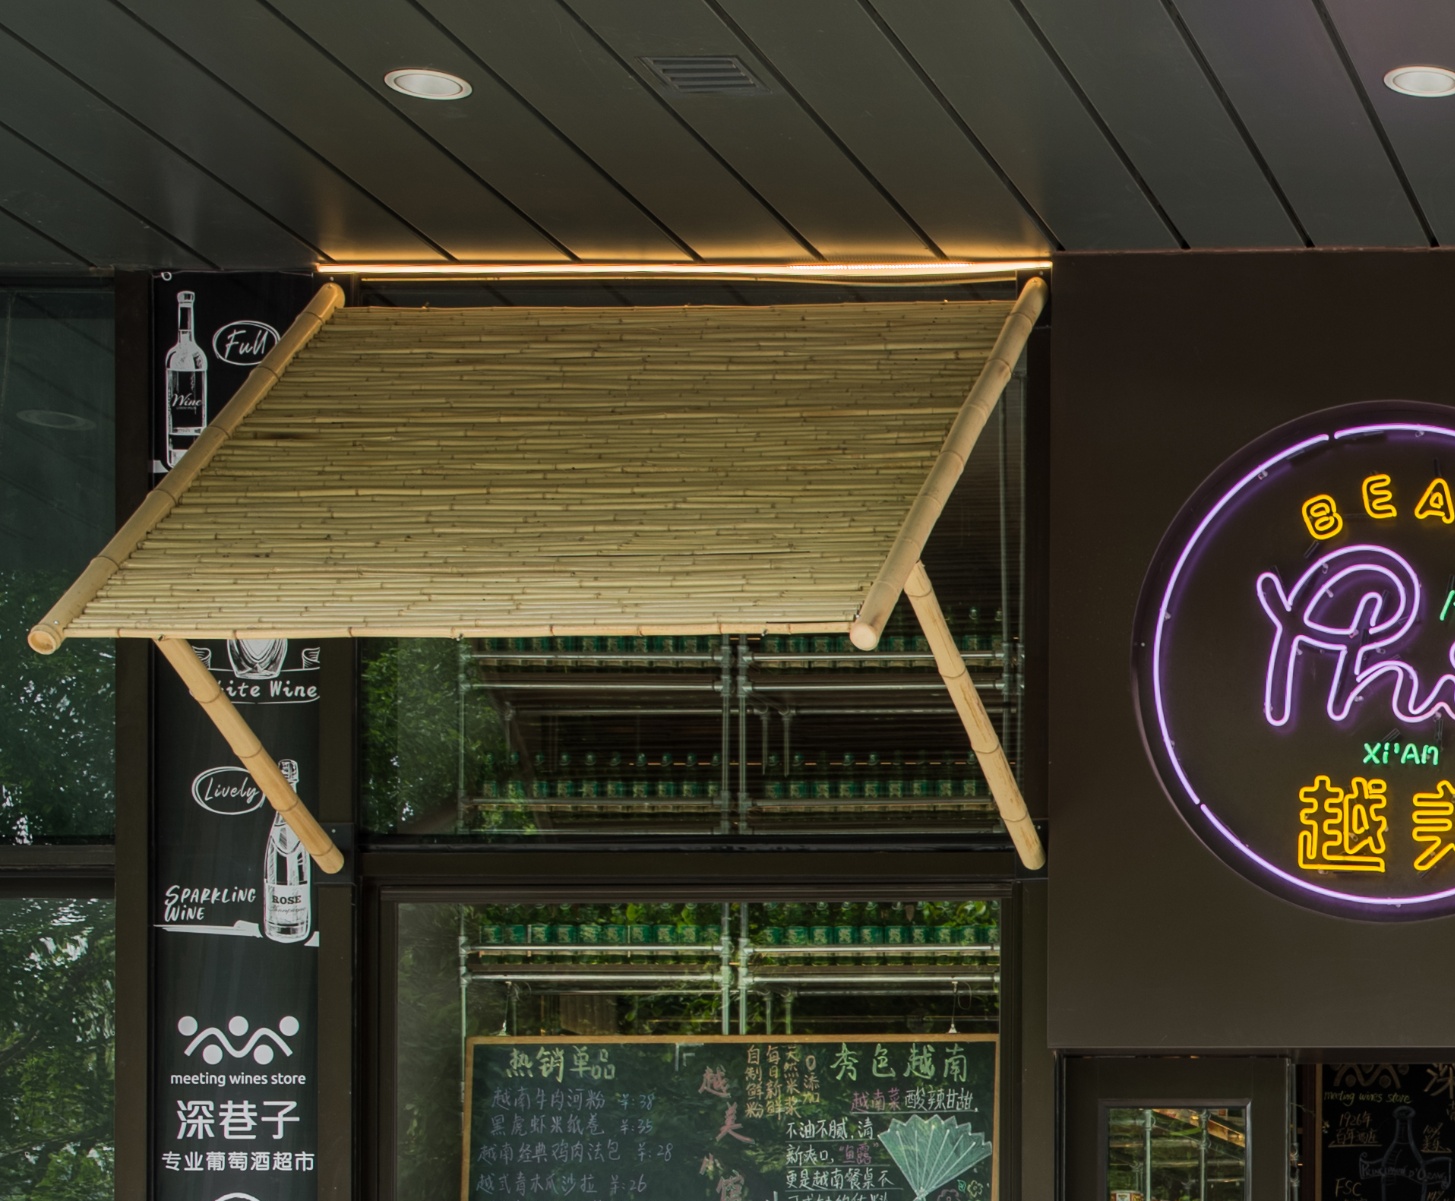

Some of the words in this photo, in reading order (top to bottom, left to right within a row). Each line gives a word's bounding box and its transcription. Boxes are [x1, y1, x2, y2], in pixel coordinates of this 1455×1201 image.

[225, 329, 269, 360] Full
[270, 680, 318, 697] Wine
[204, 777, 260, 804] Lively
[506, 1046, 616, 1083] 热销单品
[830, 1042, 968, 1082] 秀色越南
[170, 1072, 226, 1087] meeting
[229, 1072, 268, 1085] wines
[271, 1073, 306, 1085] store
[745, 1045, 763, 1119] 自制鲜粉
[766, 1045, 783, 1120] 每日新鲜
[491, 1086, 605, 1112] 越南牛肉河粉
[176, 1099, 300, 1140] 深巷子
[161, 1150, 315, 1172] 专业葡萄酒超市
[477, 1139, 621, 1165] 越南经典鸡肉法包
[476, 1171, 597, 1196] 越式青木瓜沙拉
[1335, 1177, 1362, 1197] FSC
